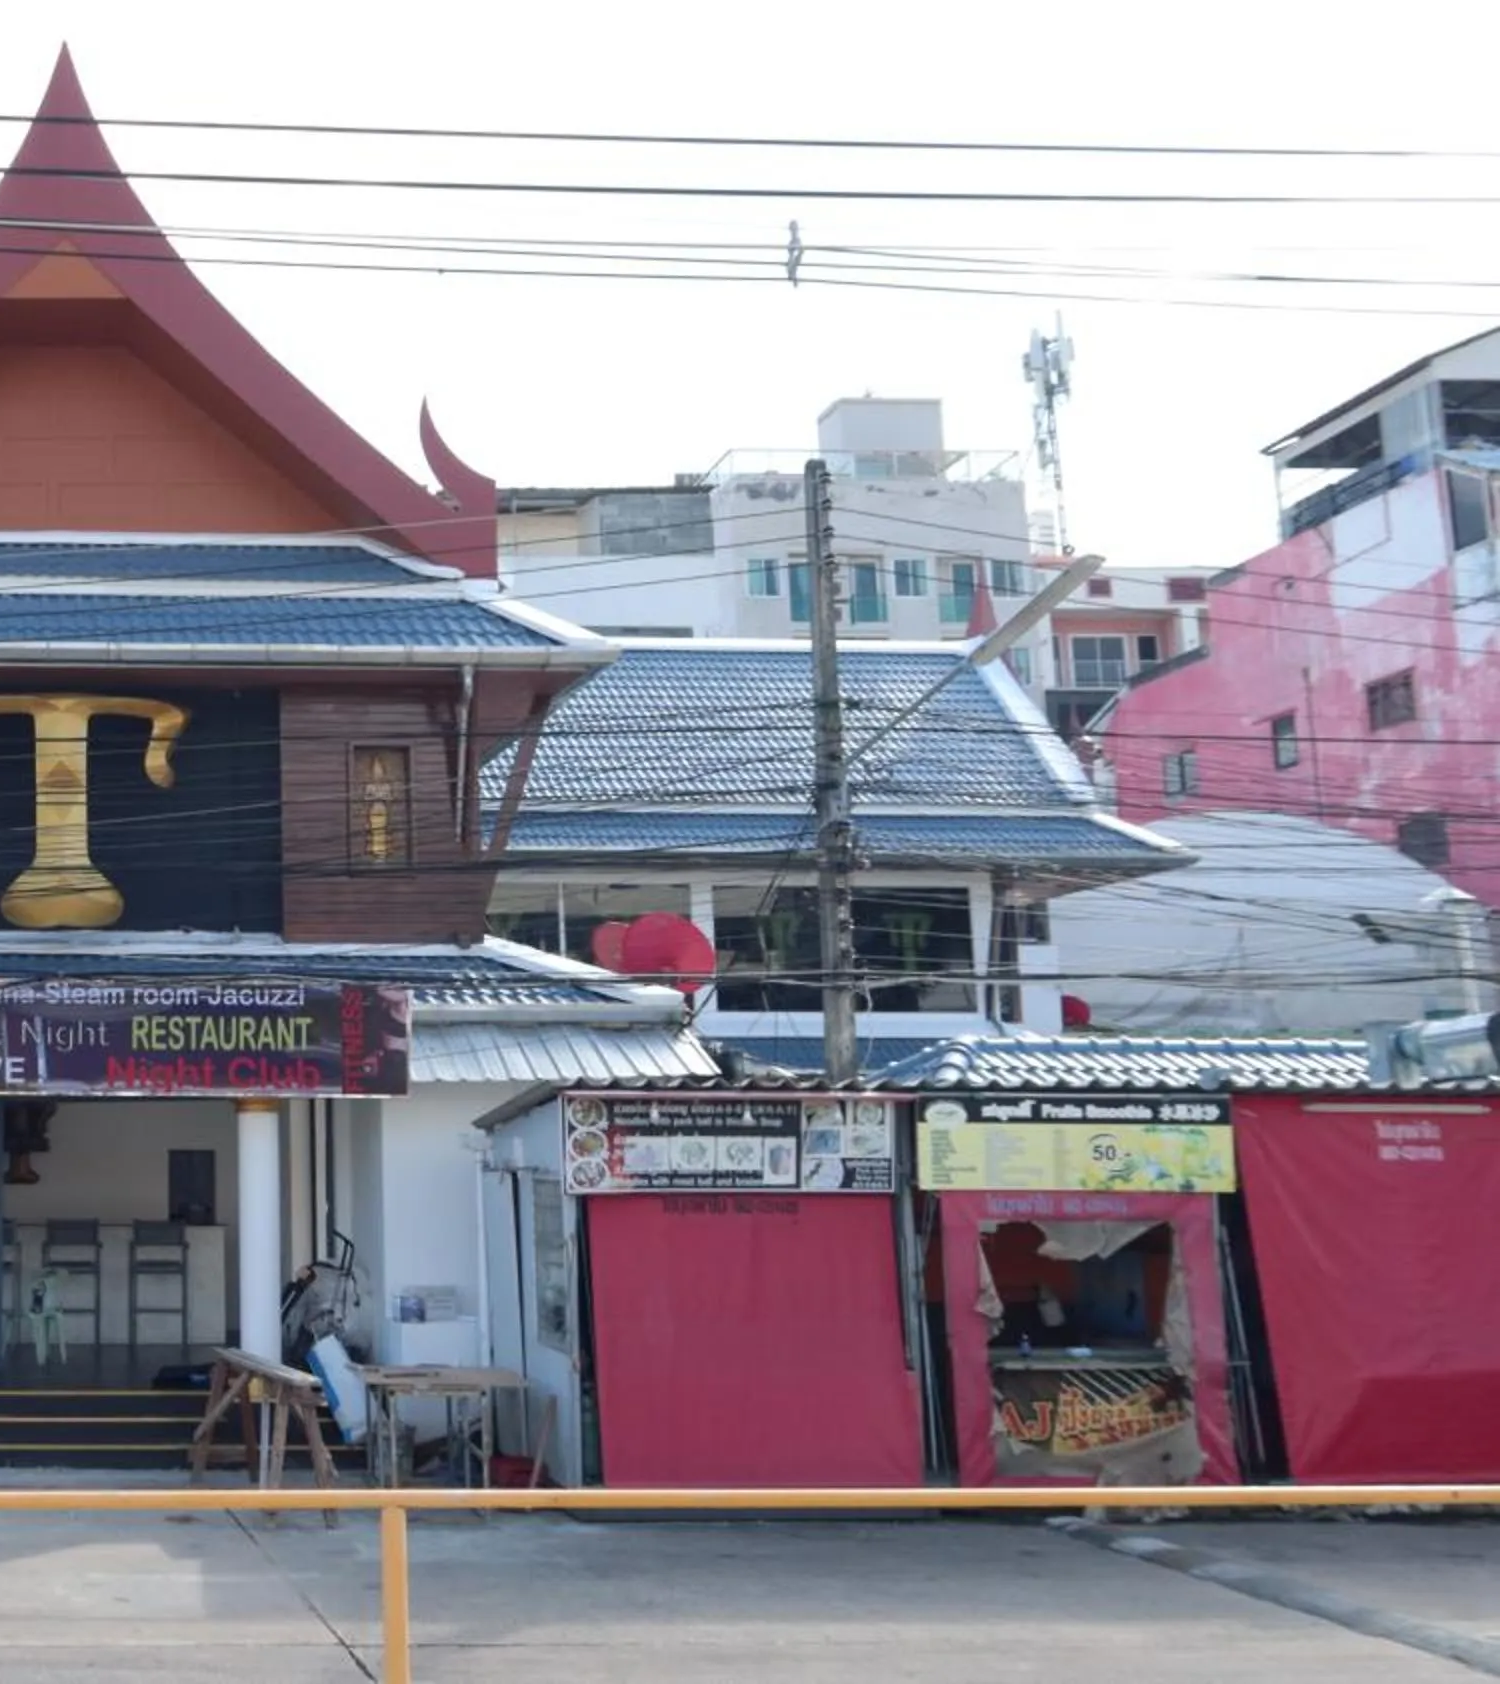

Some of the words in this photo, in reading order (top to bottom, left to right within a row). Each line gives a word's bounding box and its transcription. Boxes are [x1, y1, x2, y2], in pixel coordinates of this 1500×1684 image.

[20, 1019, 110, 1053] Night
[131, 1016, 314, 1052] RESTAURANT
[106, 1055, 214, 1096] Night
[228, 1056, 323, 1092] Club
